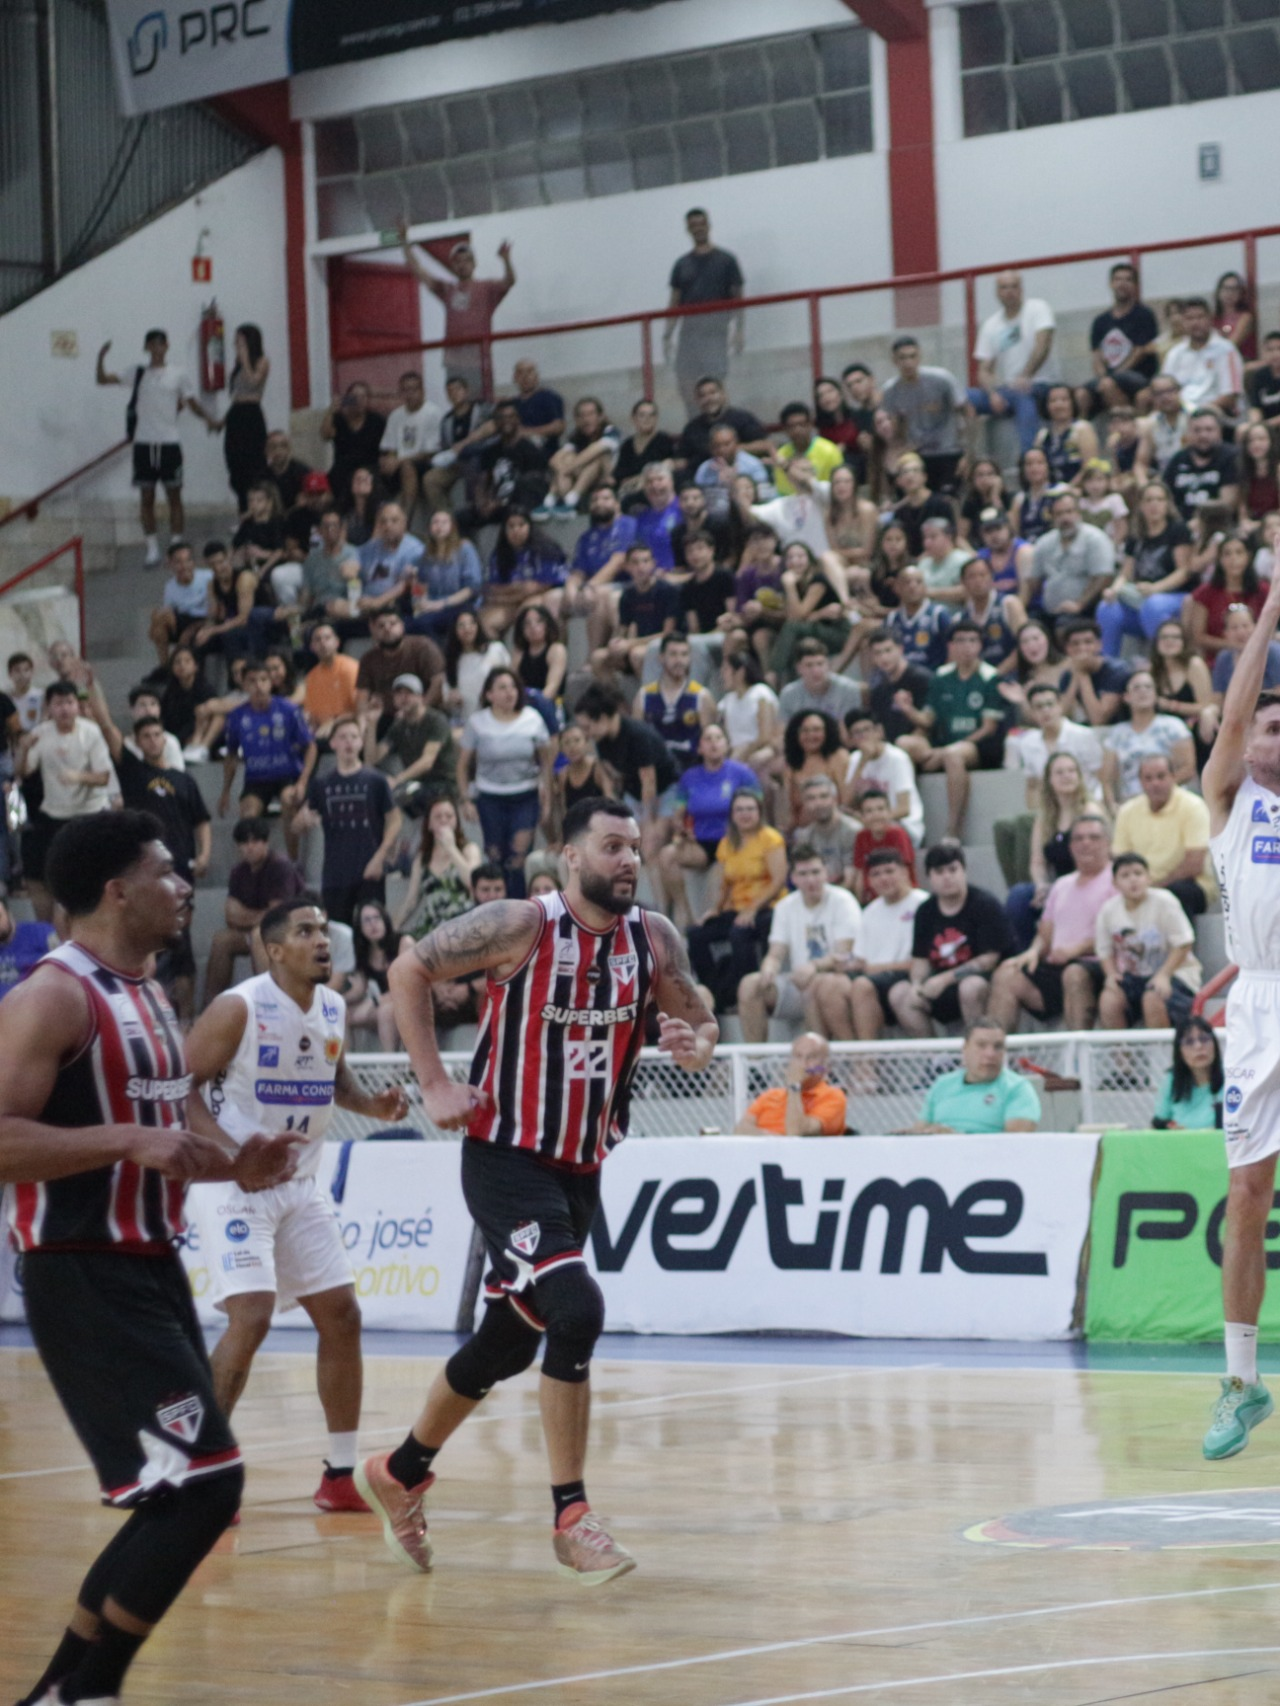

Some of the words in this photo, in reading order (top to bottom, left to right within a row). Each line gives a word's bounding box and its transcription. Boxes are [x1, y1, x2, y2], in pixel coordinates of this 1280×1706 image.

[180, 0, 270, 54] PRC
[541, 1002, 638, 1025] SUPERBET
[565, 1040, 610, 1079] 22
[257, 1083, 299, 1096] FARMA
[302, 1084, 334, 1096] COND
[286, 1115, 310, 1133] 14
[230, 1223, 247, 1236] elo
[367, 1207, 433, 1260] josé
